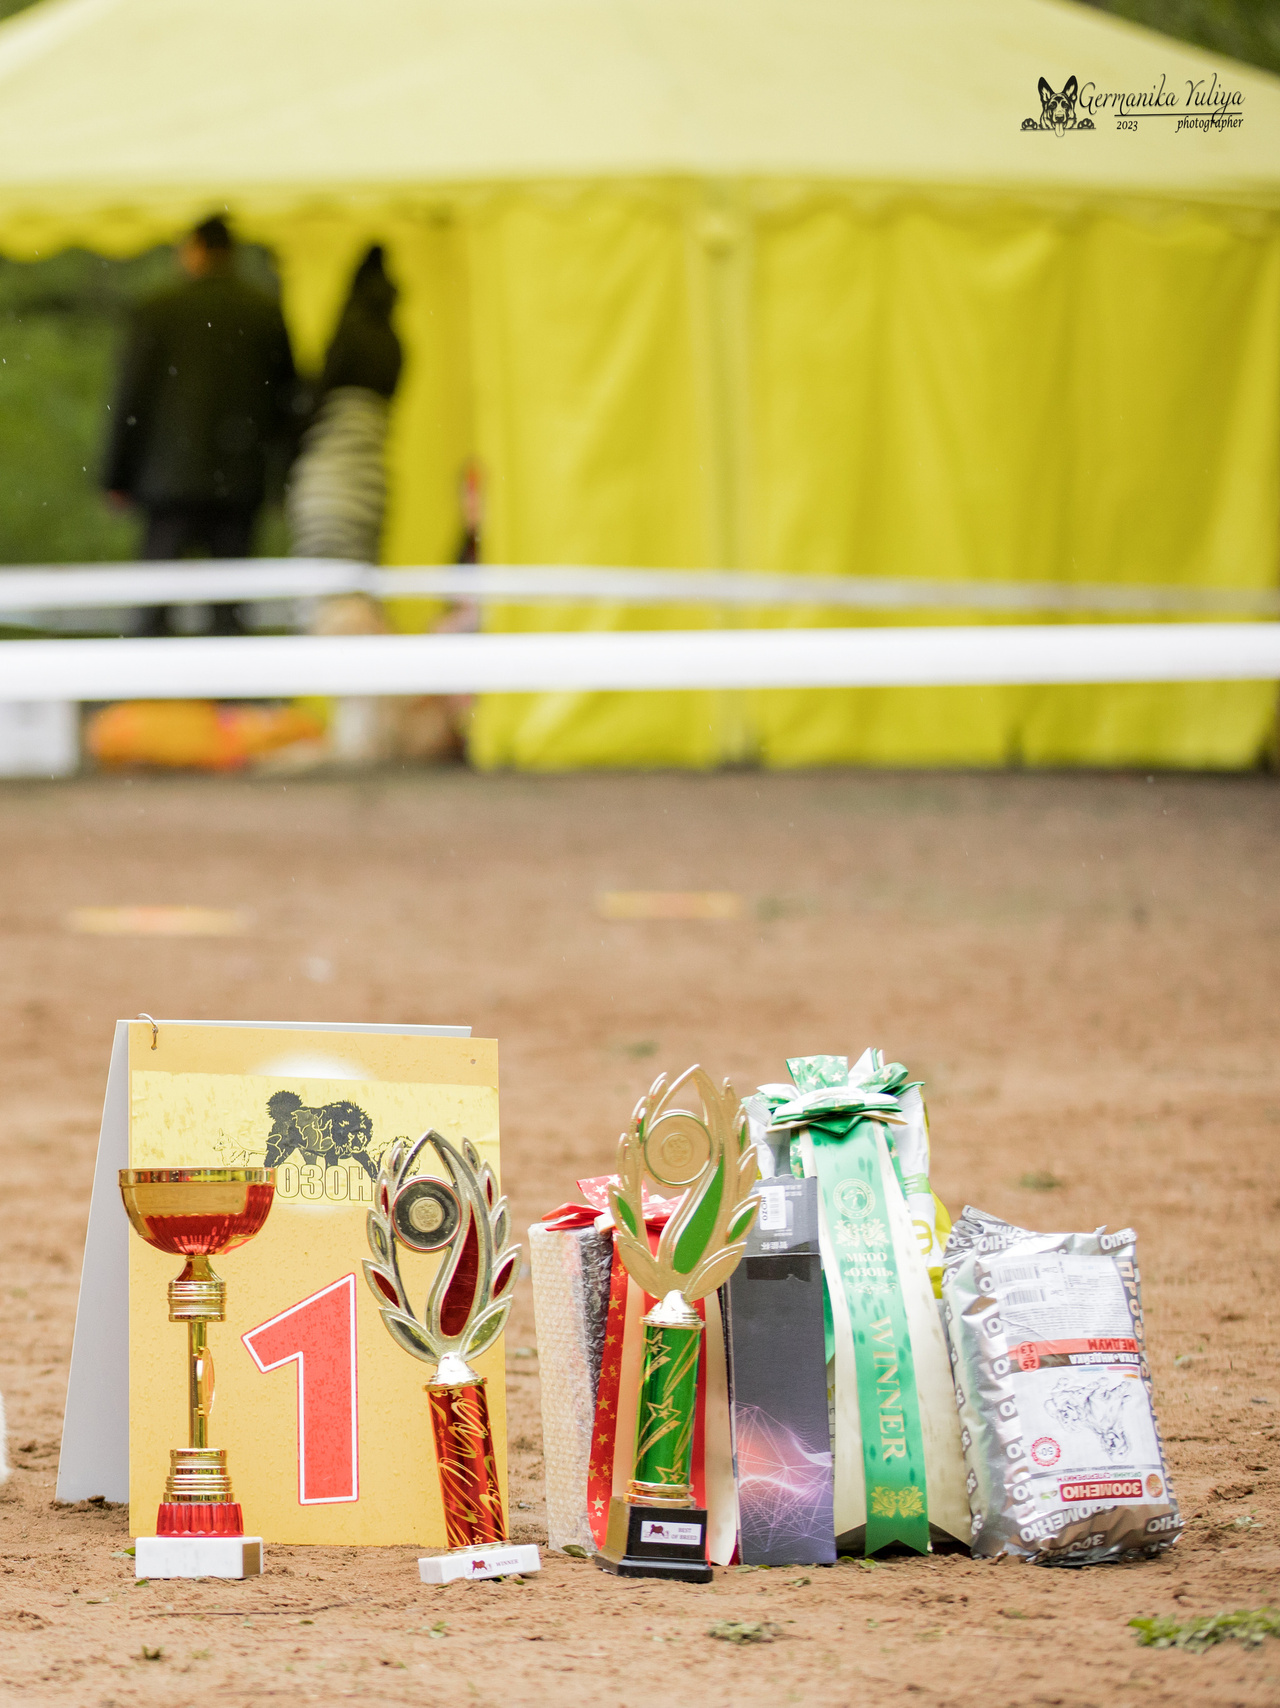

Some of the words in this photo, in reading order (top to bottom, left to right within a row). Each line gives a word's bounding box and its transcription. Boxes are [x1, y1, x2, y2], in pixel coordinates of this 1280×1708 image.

[276, 1162, 373, 1202] ОЗОН
[1087, 1338, 1136, 1350] МЕДИУМ
[1022, 1359, 1036, 1370] 25
[240, 1272, 359, 1505] 1
[869, 1315, 907, 1461] WINNER
[1062, 1482, 1142, 1499] ЗООМЕНЮ
[495, 1559, 519, 1567] WINNER
